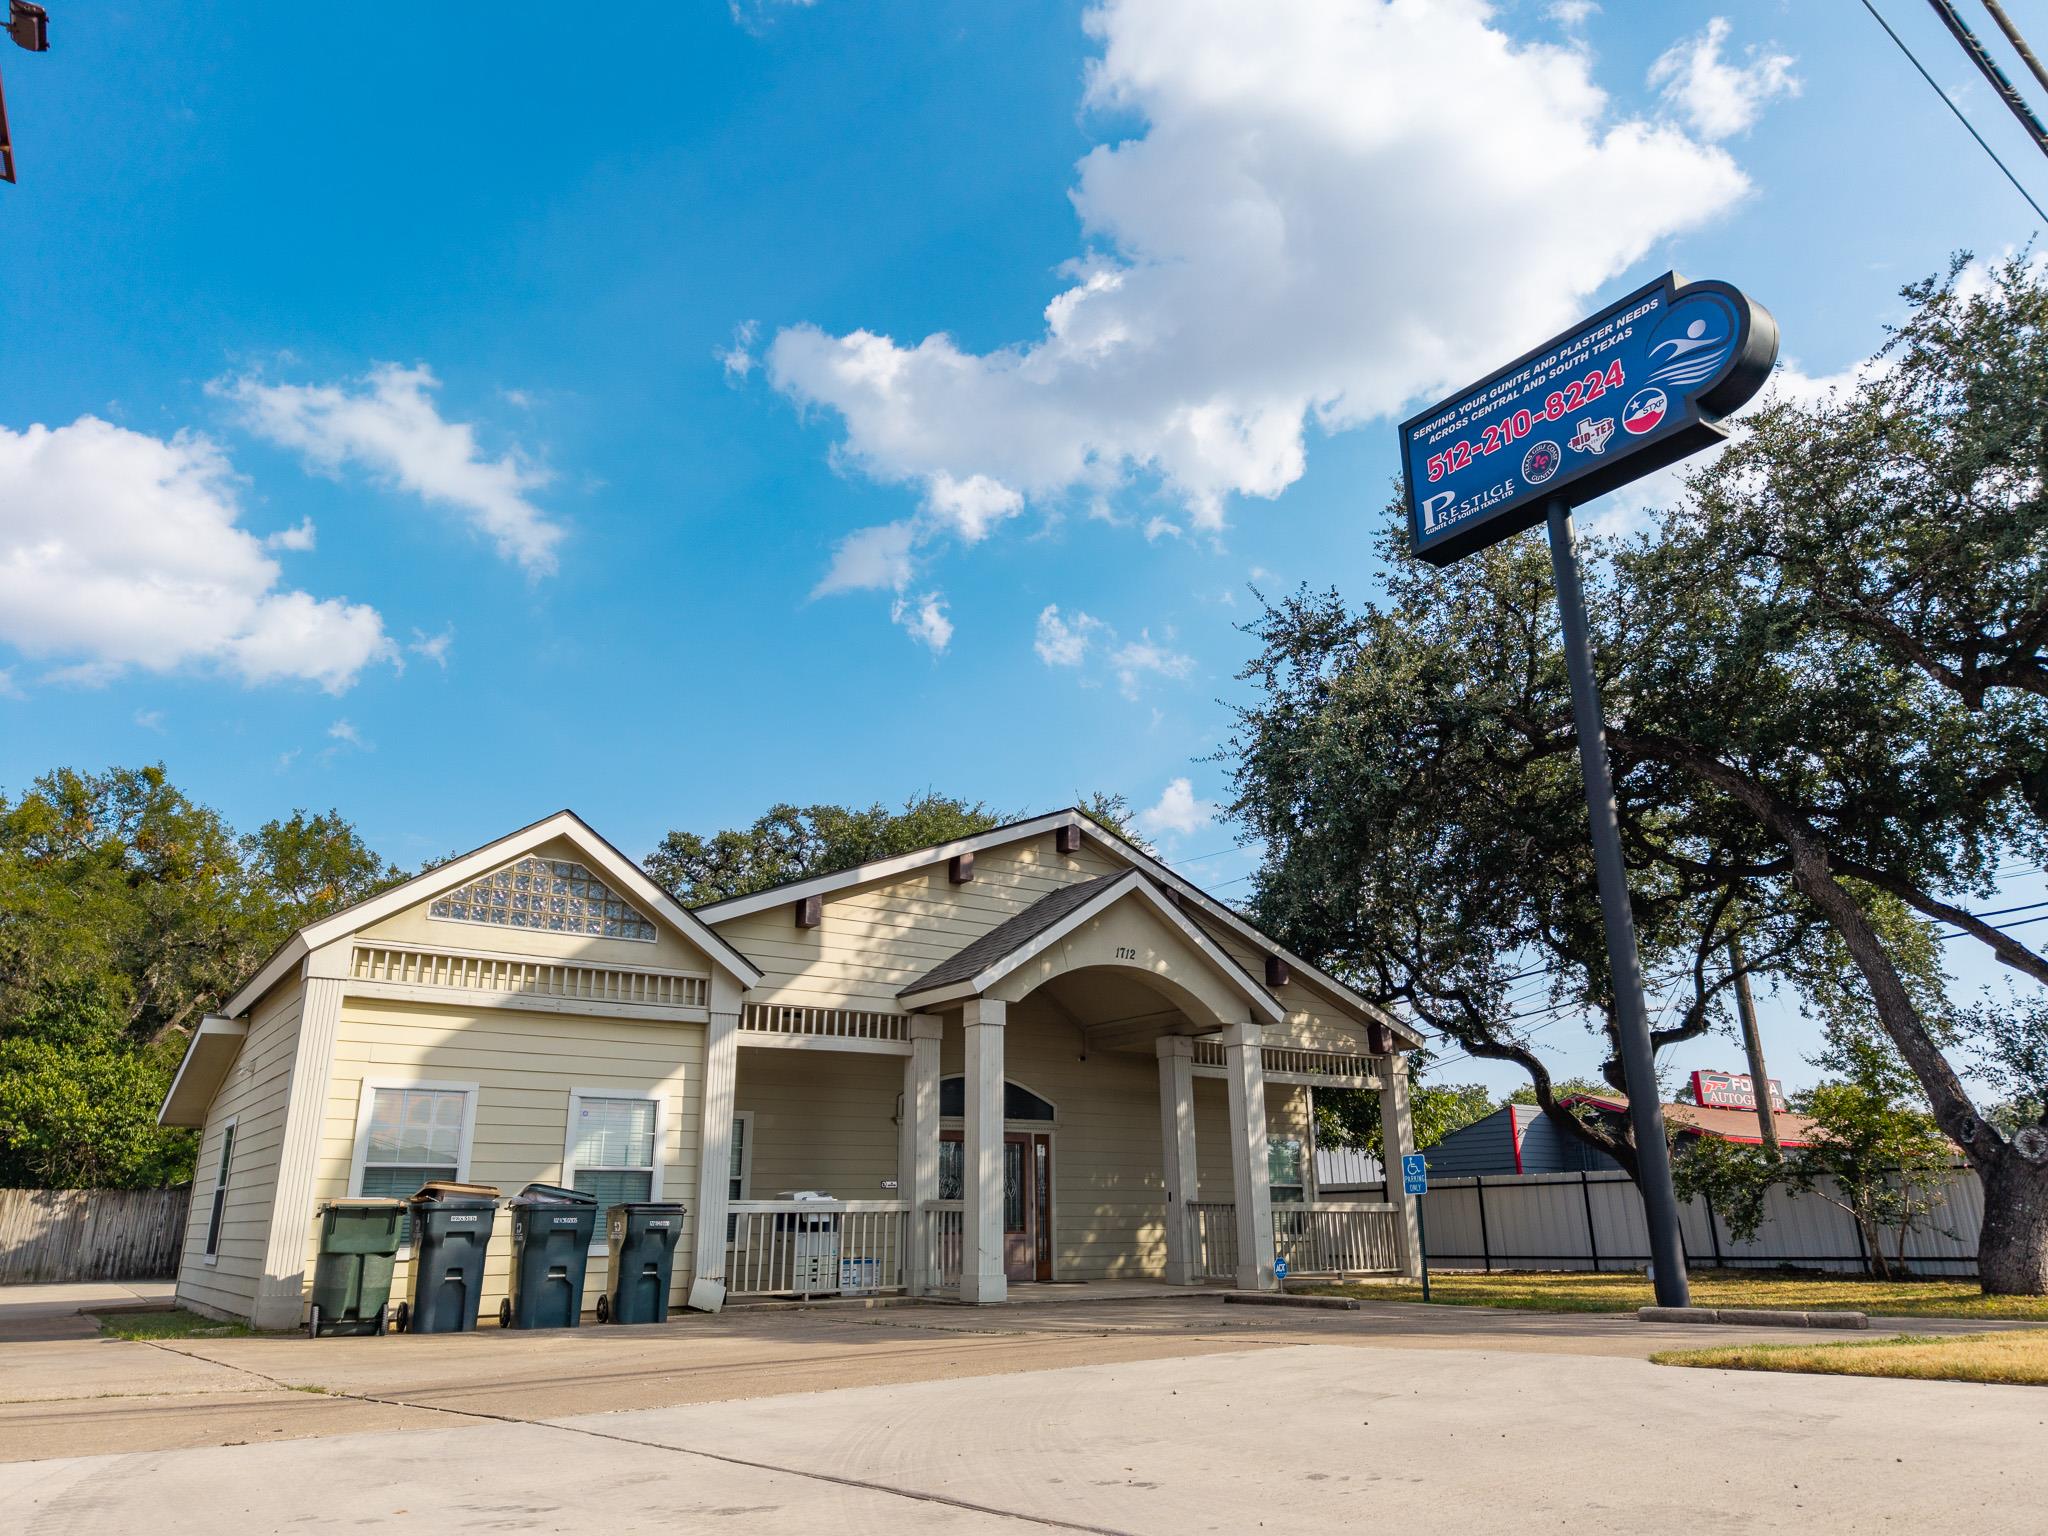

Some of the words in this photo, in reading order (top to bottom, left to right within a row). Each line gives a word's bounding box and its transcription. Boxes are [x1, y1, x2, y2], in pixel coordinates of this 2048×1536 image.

[1413, 411, 1456, 440] SERVING
[1458, 393, 1487, 415] YOUR
[1489, 370, 1531, 398] GUNITE
[1532, 355, 1557, 376] AND
[1560, 324, 1613, 360] PLASTER
[1616, 298, 1659, 329] NEEDS
[1428, 417, 1469, 445] ACROSS
[1471, 390, 1520, 421] CENTRAL
[1522, 375, 1546, 394] AND
[1548, 350, 1589, 379] SOUTH
[1592, 327, 1633, 355] TEXAS
[1642, 398, 1664, 415] STXP
[1426, 358, 1626, 483] 512-210-8224
[1571, 420, 1614, 448] MID-TEX
[1531, 467, 1555, 481] GUNITE
[1421, 479, 1515, 531] PRESTIGE
[1425, 521, 1448, 535] GUNITE
[1448, 517, 1457, 525] OF
[1457, 506, 1480, 521] SOUTH
[1501, 489, 1514, 500] LTD
[1115, 947, 1136, 960] 1712
[1731, 1078, 1779, 1096] FOA
[1710, 1091, 1782, 1109] AUTOGP
[1404, 1175, 1425, 1183] PARKING
